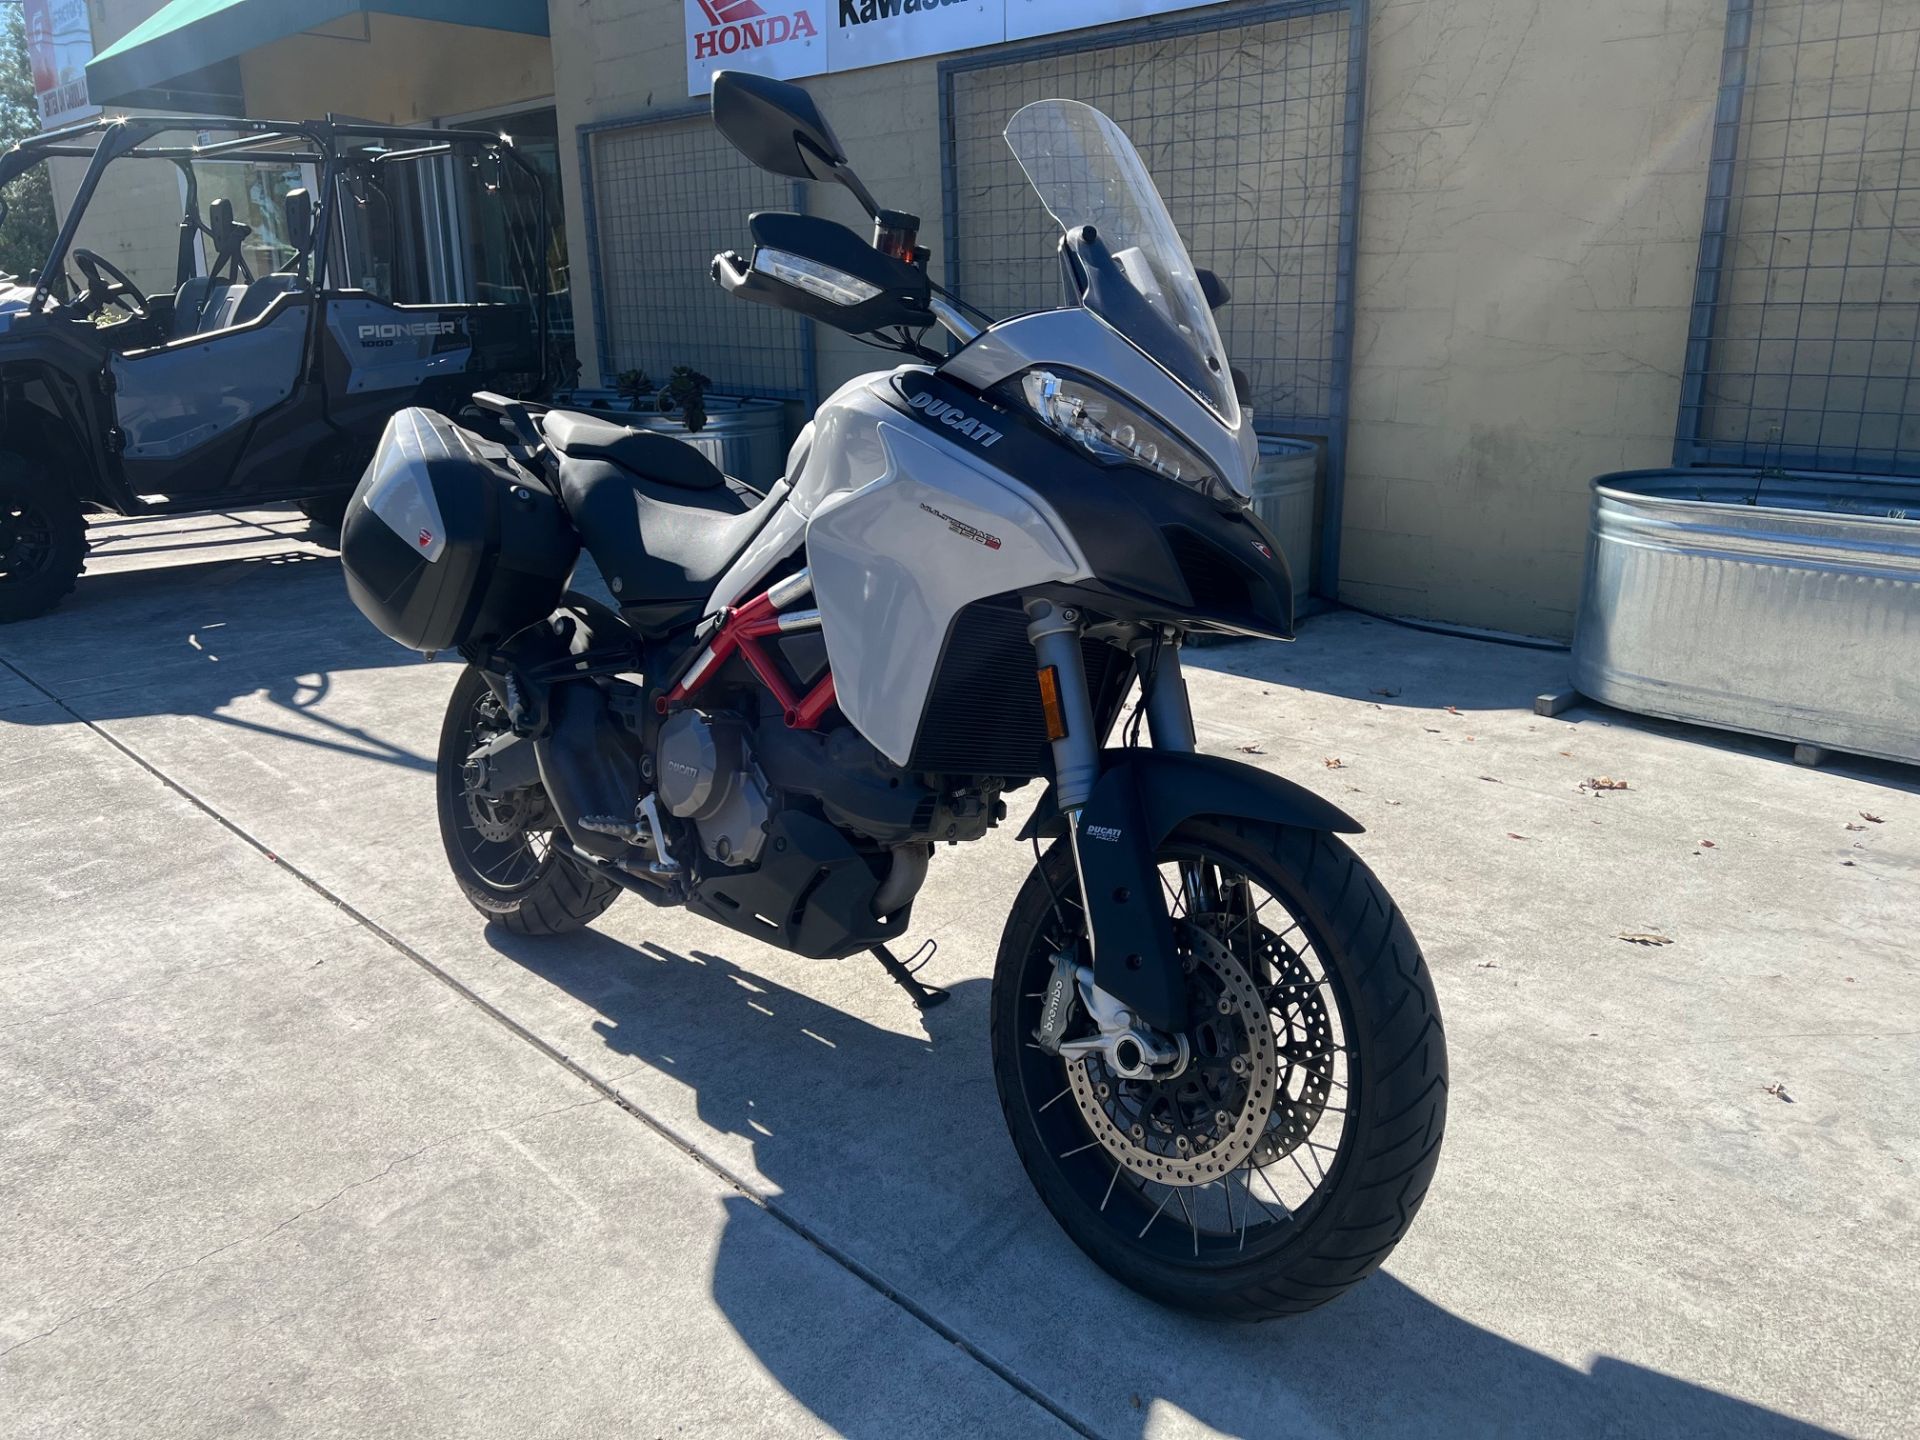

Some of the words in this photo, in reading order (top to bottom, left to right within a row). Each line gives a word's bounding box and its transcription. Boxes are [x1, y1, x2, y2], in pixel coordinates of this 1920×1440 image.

[694, 10, 818, 59] HONDA
[358, 321, 455, 338] PIONEER
[360, 340, 393, 348] 1000
[907, 391, 1004, 447] DUCATI
[669, 760, 698, 778] DUCATI
[1087, 825, 1122, 837] DUCATI
[1044, 980, 1063, 1032] brembo
